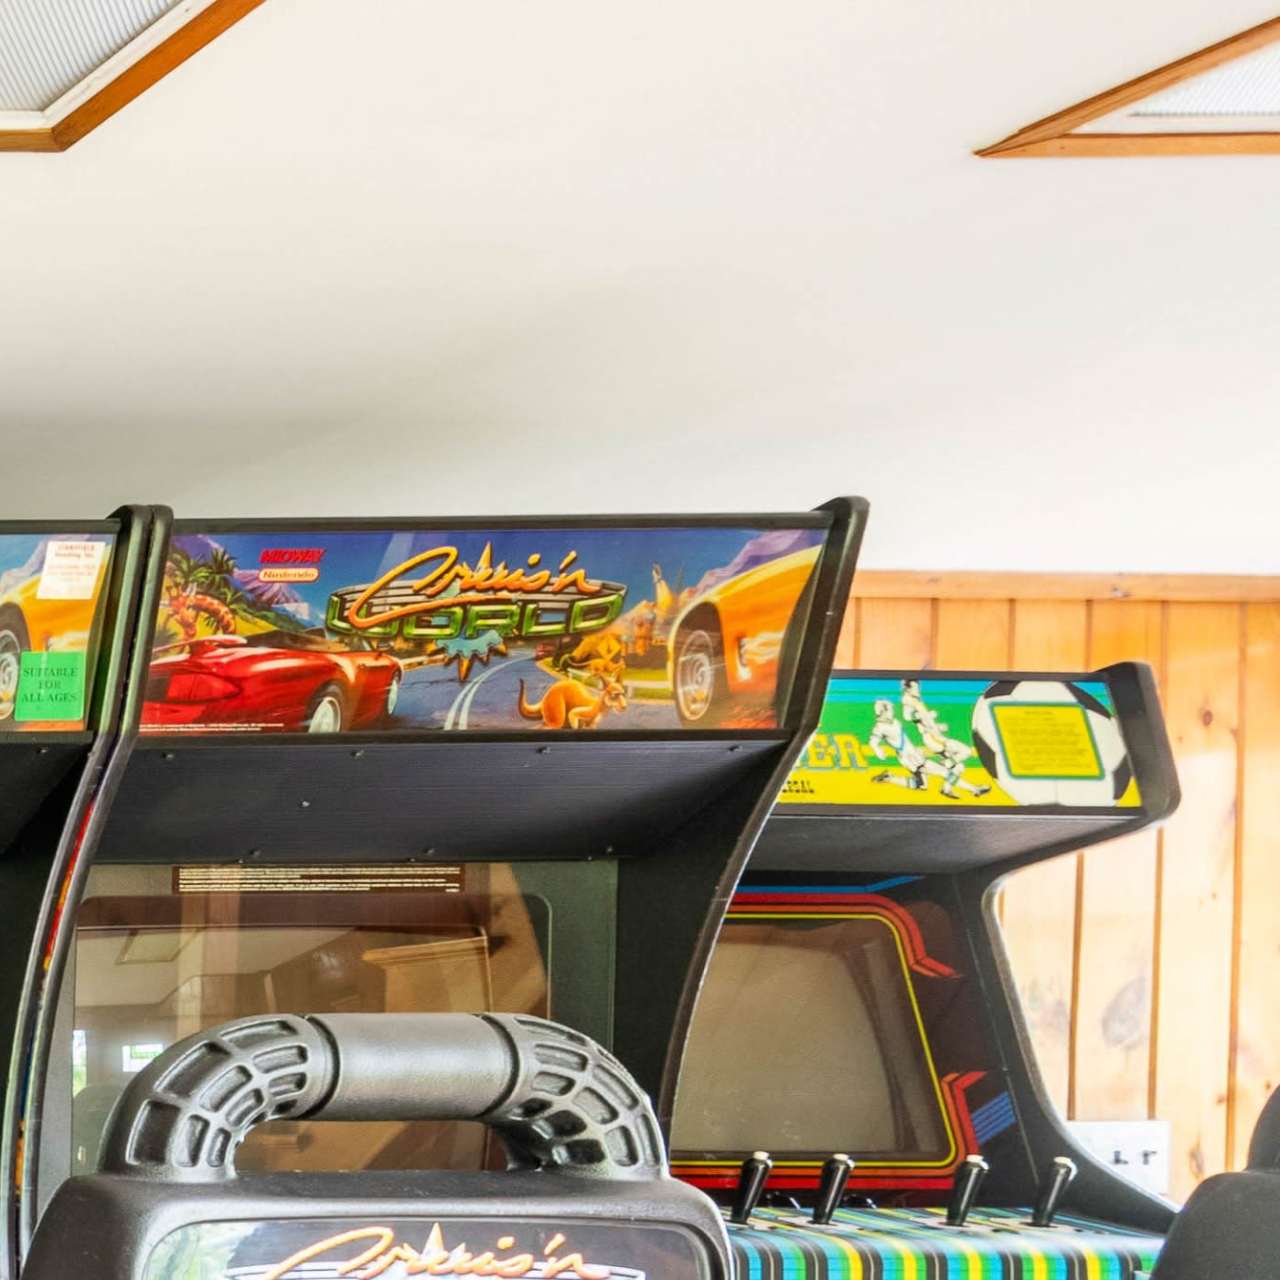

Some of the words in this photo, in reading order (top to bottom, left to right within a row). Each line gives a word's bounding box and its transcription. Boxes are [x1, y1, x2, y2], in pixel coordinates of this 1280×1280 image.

[260, 548, 325, 564] MIDWAY
[262, 569, 316, 581] Nintendo
[325, 591, 628, 640] WORLD
[23, 667, 78, 678] SUITABLE
[39, 679, 62, 690] FOR
[21, 692, 44, 703] ALL
[47, 692, 77, 704] AGES
